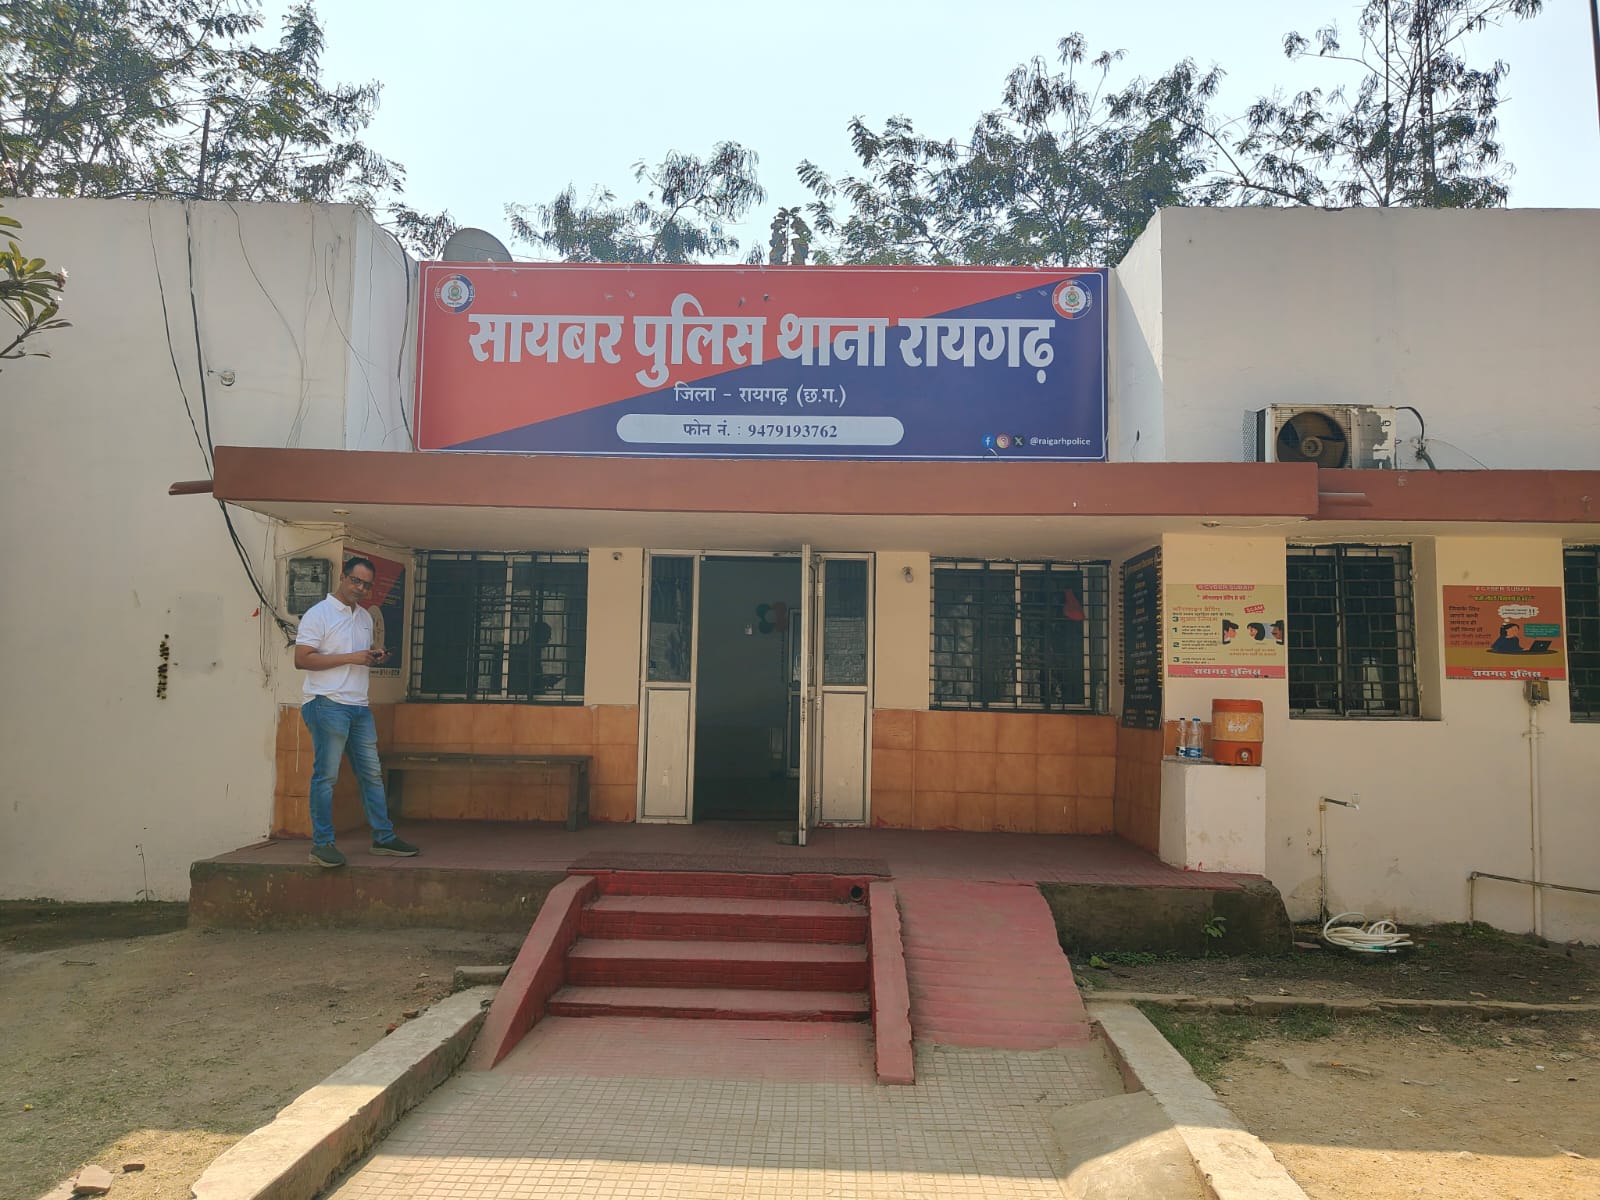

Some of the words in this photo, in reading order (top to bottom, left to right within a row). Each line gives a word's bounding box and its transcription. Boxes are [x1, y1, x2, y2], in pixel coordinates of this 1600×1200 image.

[468, 313, 624, 364] सायबर
[633, 293, 767, 388] पुलिस
[777, 313, 889, 367] थाना
[898, 317, 1056, 384] रायगढ़
[674, 381, 716, 402] जिला
[739, 387, 788, 406] रायगढ़
[796, 384, 846, 408] (छ.ग.)
[683, 419, 711, 437] फोन
[748, 424, 838, 438] 9479193762
[1030, 437, 1091, 447] @raigarhpolice
[1230, 668, 1261, 677] पुलिस
[1510, 669, 1541, 679] पुलिस
